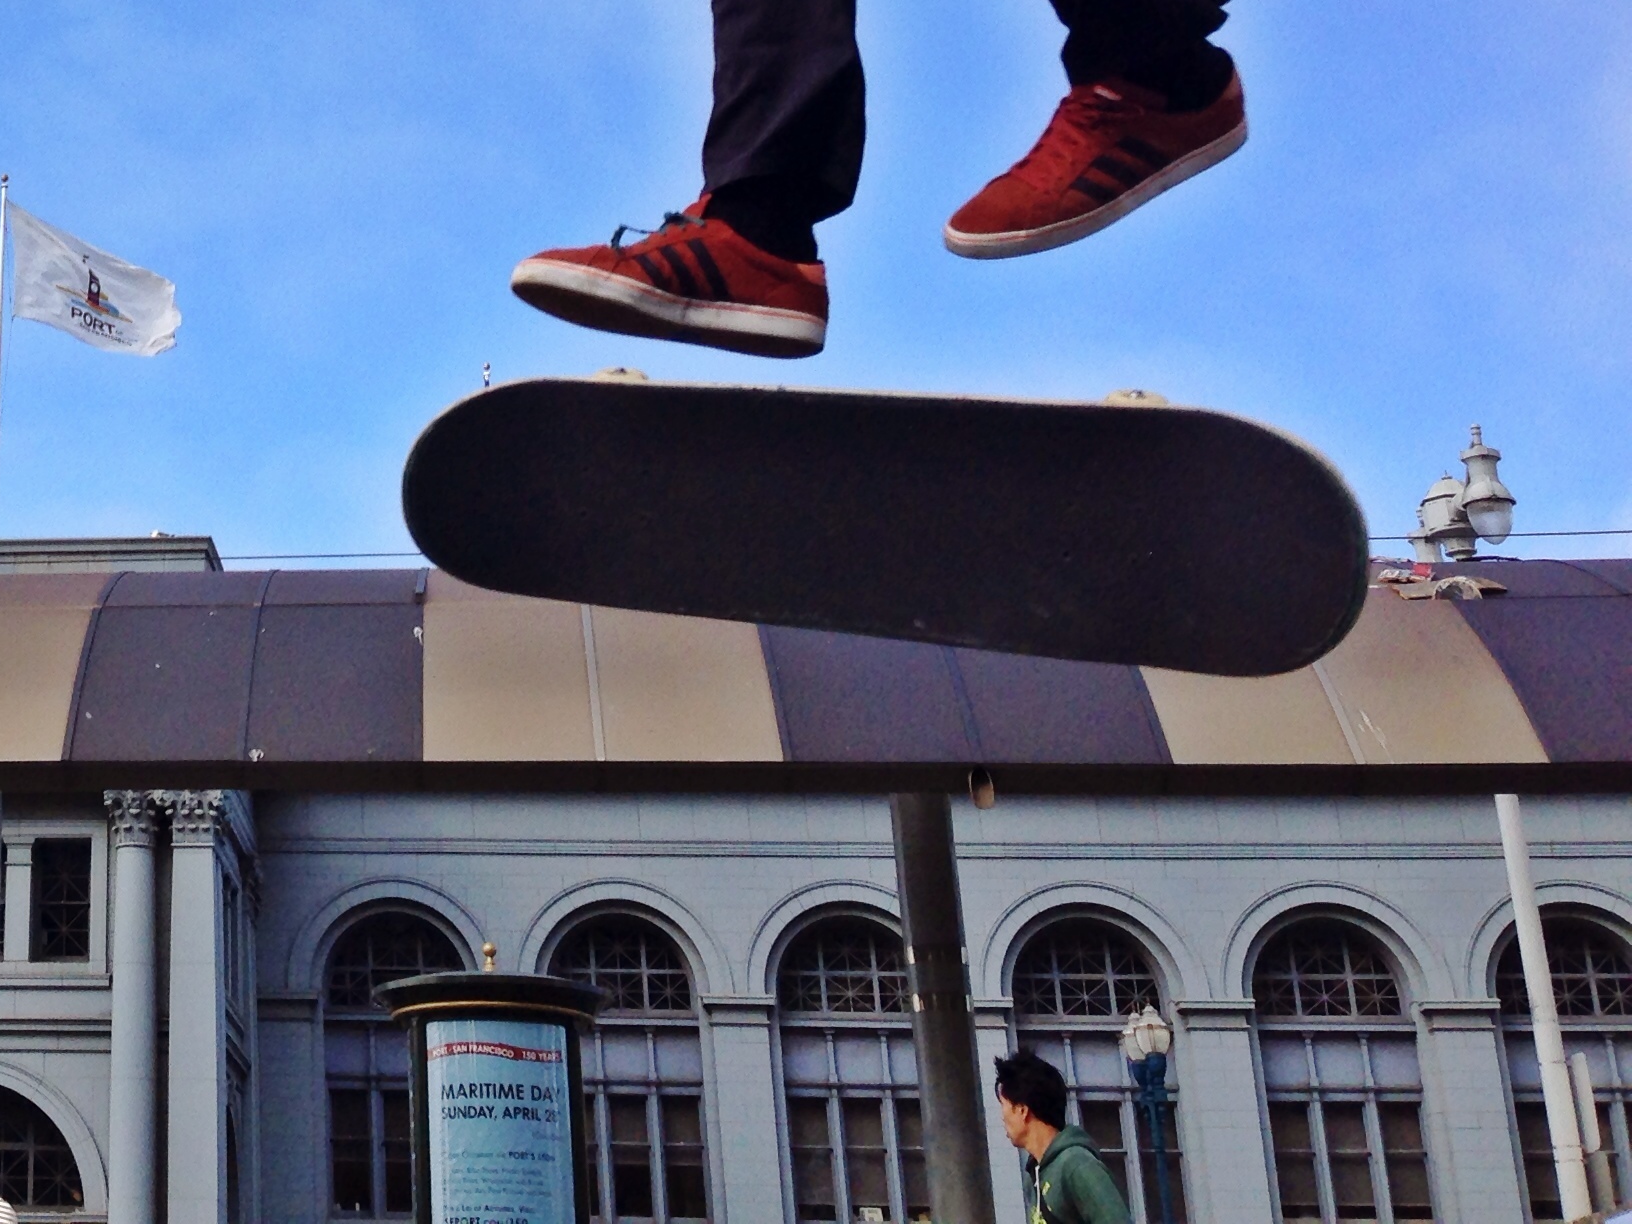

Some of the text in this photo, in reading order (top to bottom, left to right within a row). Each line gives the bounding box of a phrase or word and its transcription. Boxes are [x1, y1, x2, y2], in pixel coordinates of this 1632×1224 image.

[71, 306, 116, 335] PORT
[452, 1044, 468, 1055] SAN
[469, 1044, 515, 1059] FRANCISCO
[521, 1050, 537, 1061] 150
[441, 1082, 525, 1101] MARITIME
[441, 1105, 497, 1122] SUNDAY,
[502, 1106, 541, 1122] APRIL
